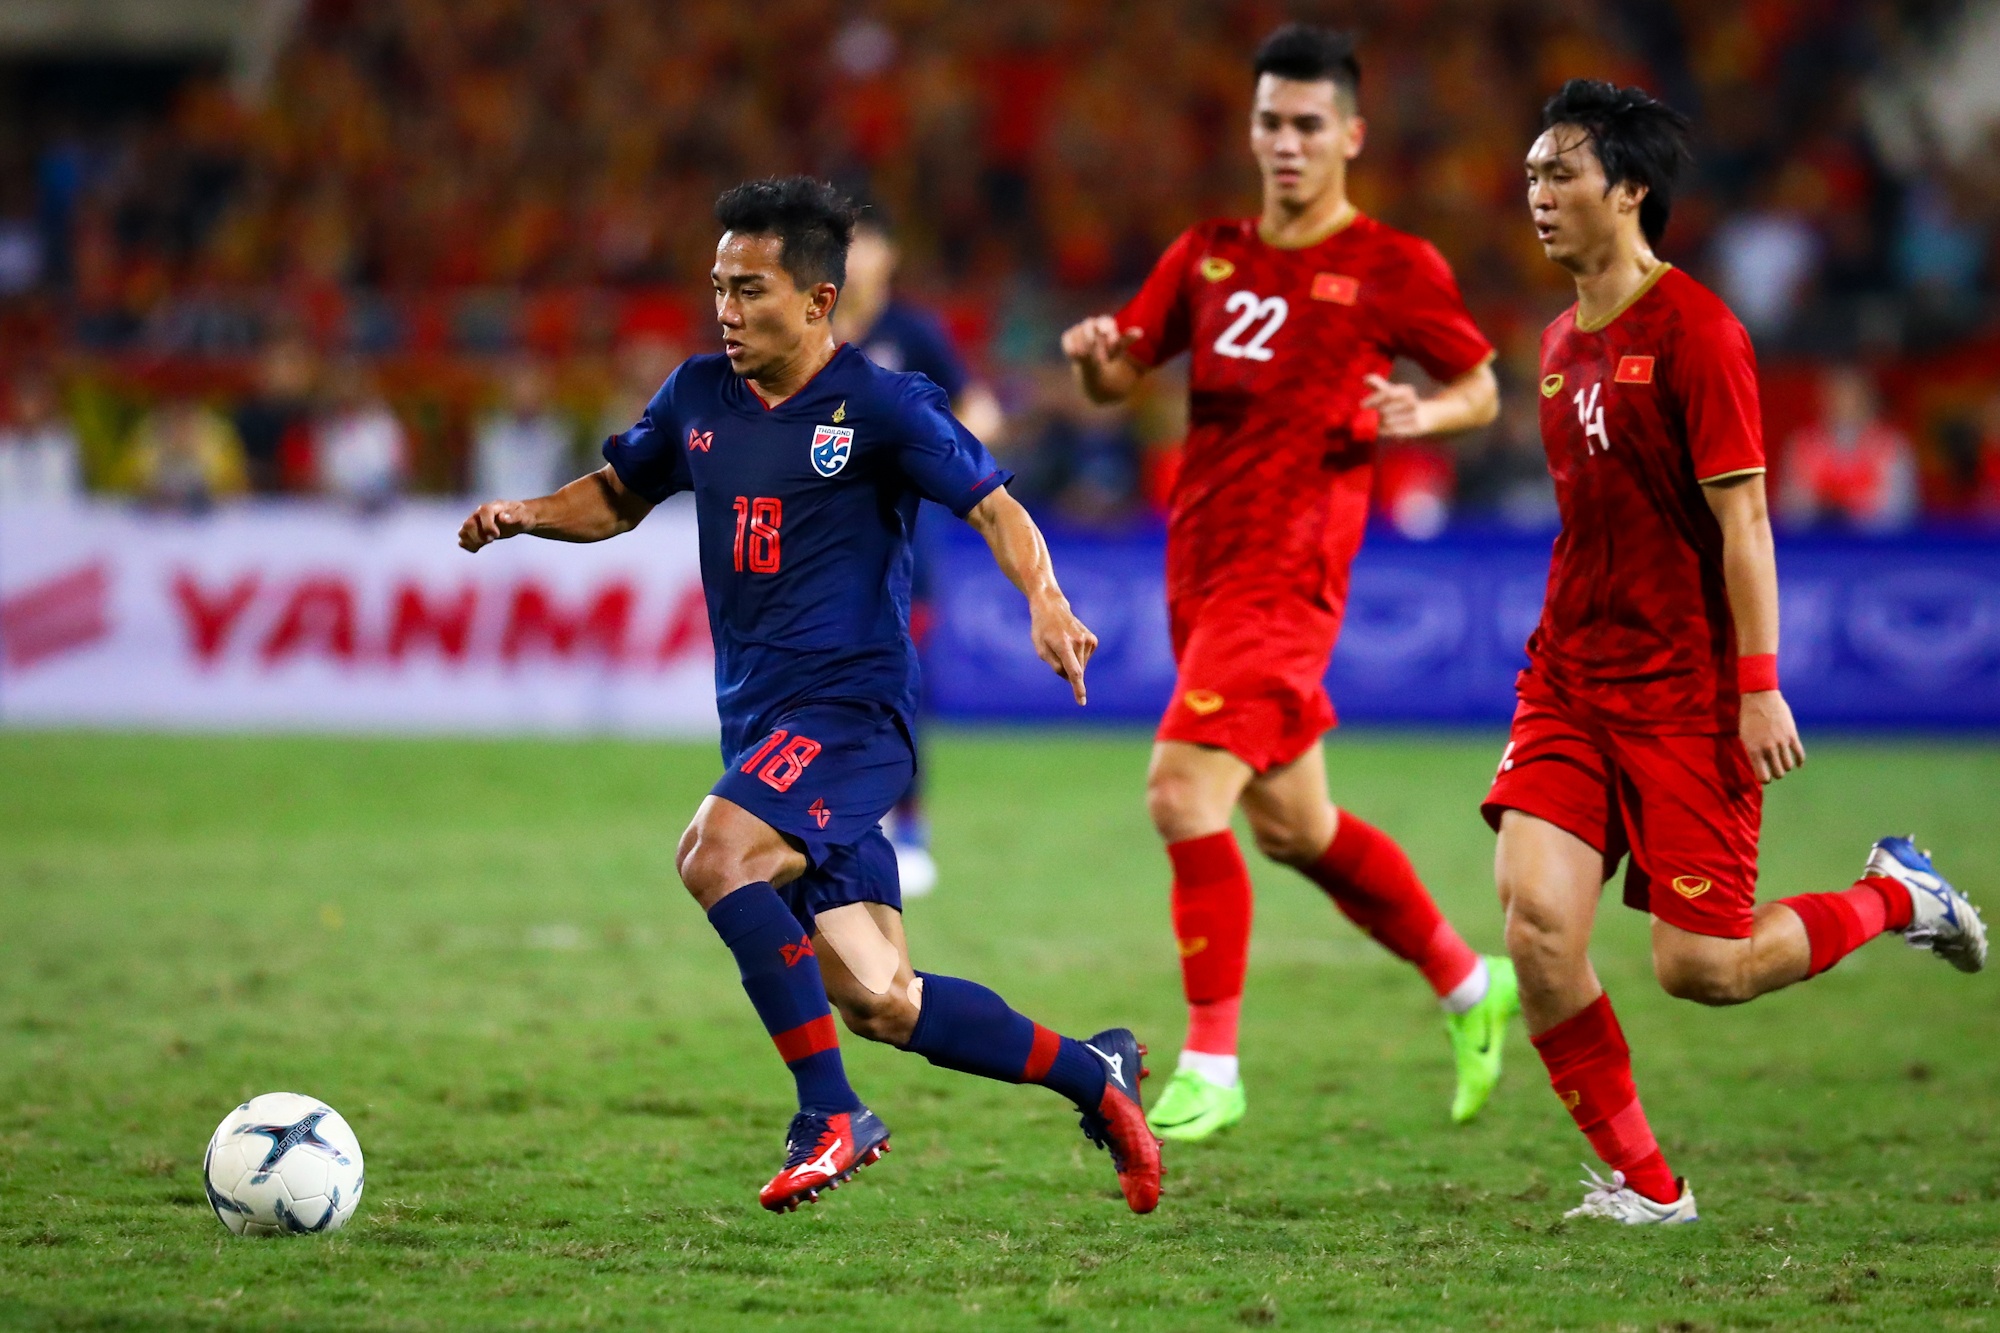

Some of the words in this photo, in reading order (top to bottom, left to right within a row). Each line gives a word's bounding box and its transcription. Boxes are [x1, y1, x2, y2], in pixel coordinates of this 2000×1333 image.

[1213, 290, 1289, 362] 22
[817, 427, 851, 437] THAILAND
[1573, 382, 1610, 456] 14
[732, 496, 783, 574] 18
[740, 729, 822, 793] 18
[273, 1114, 317, 1160] PRIMERA
